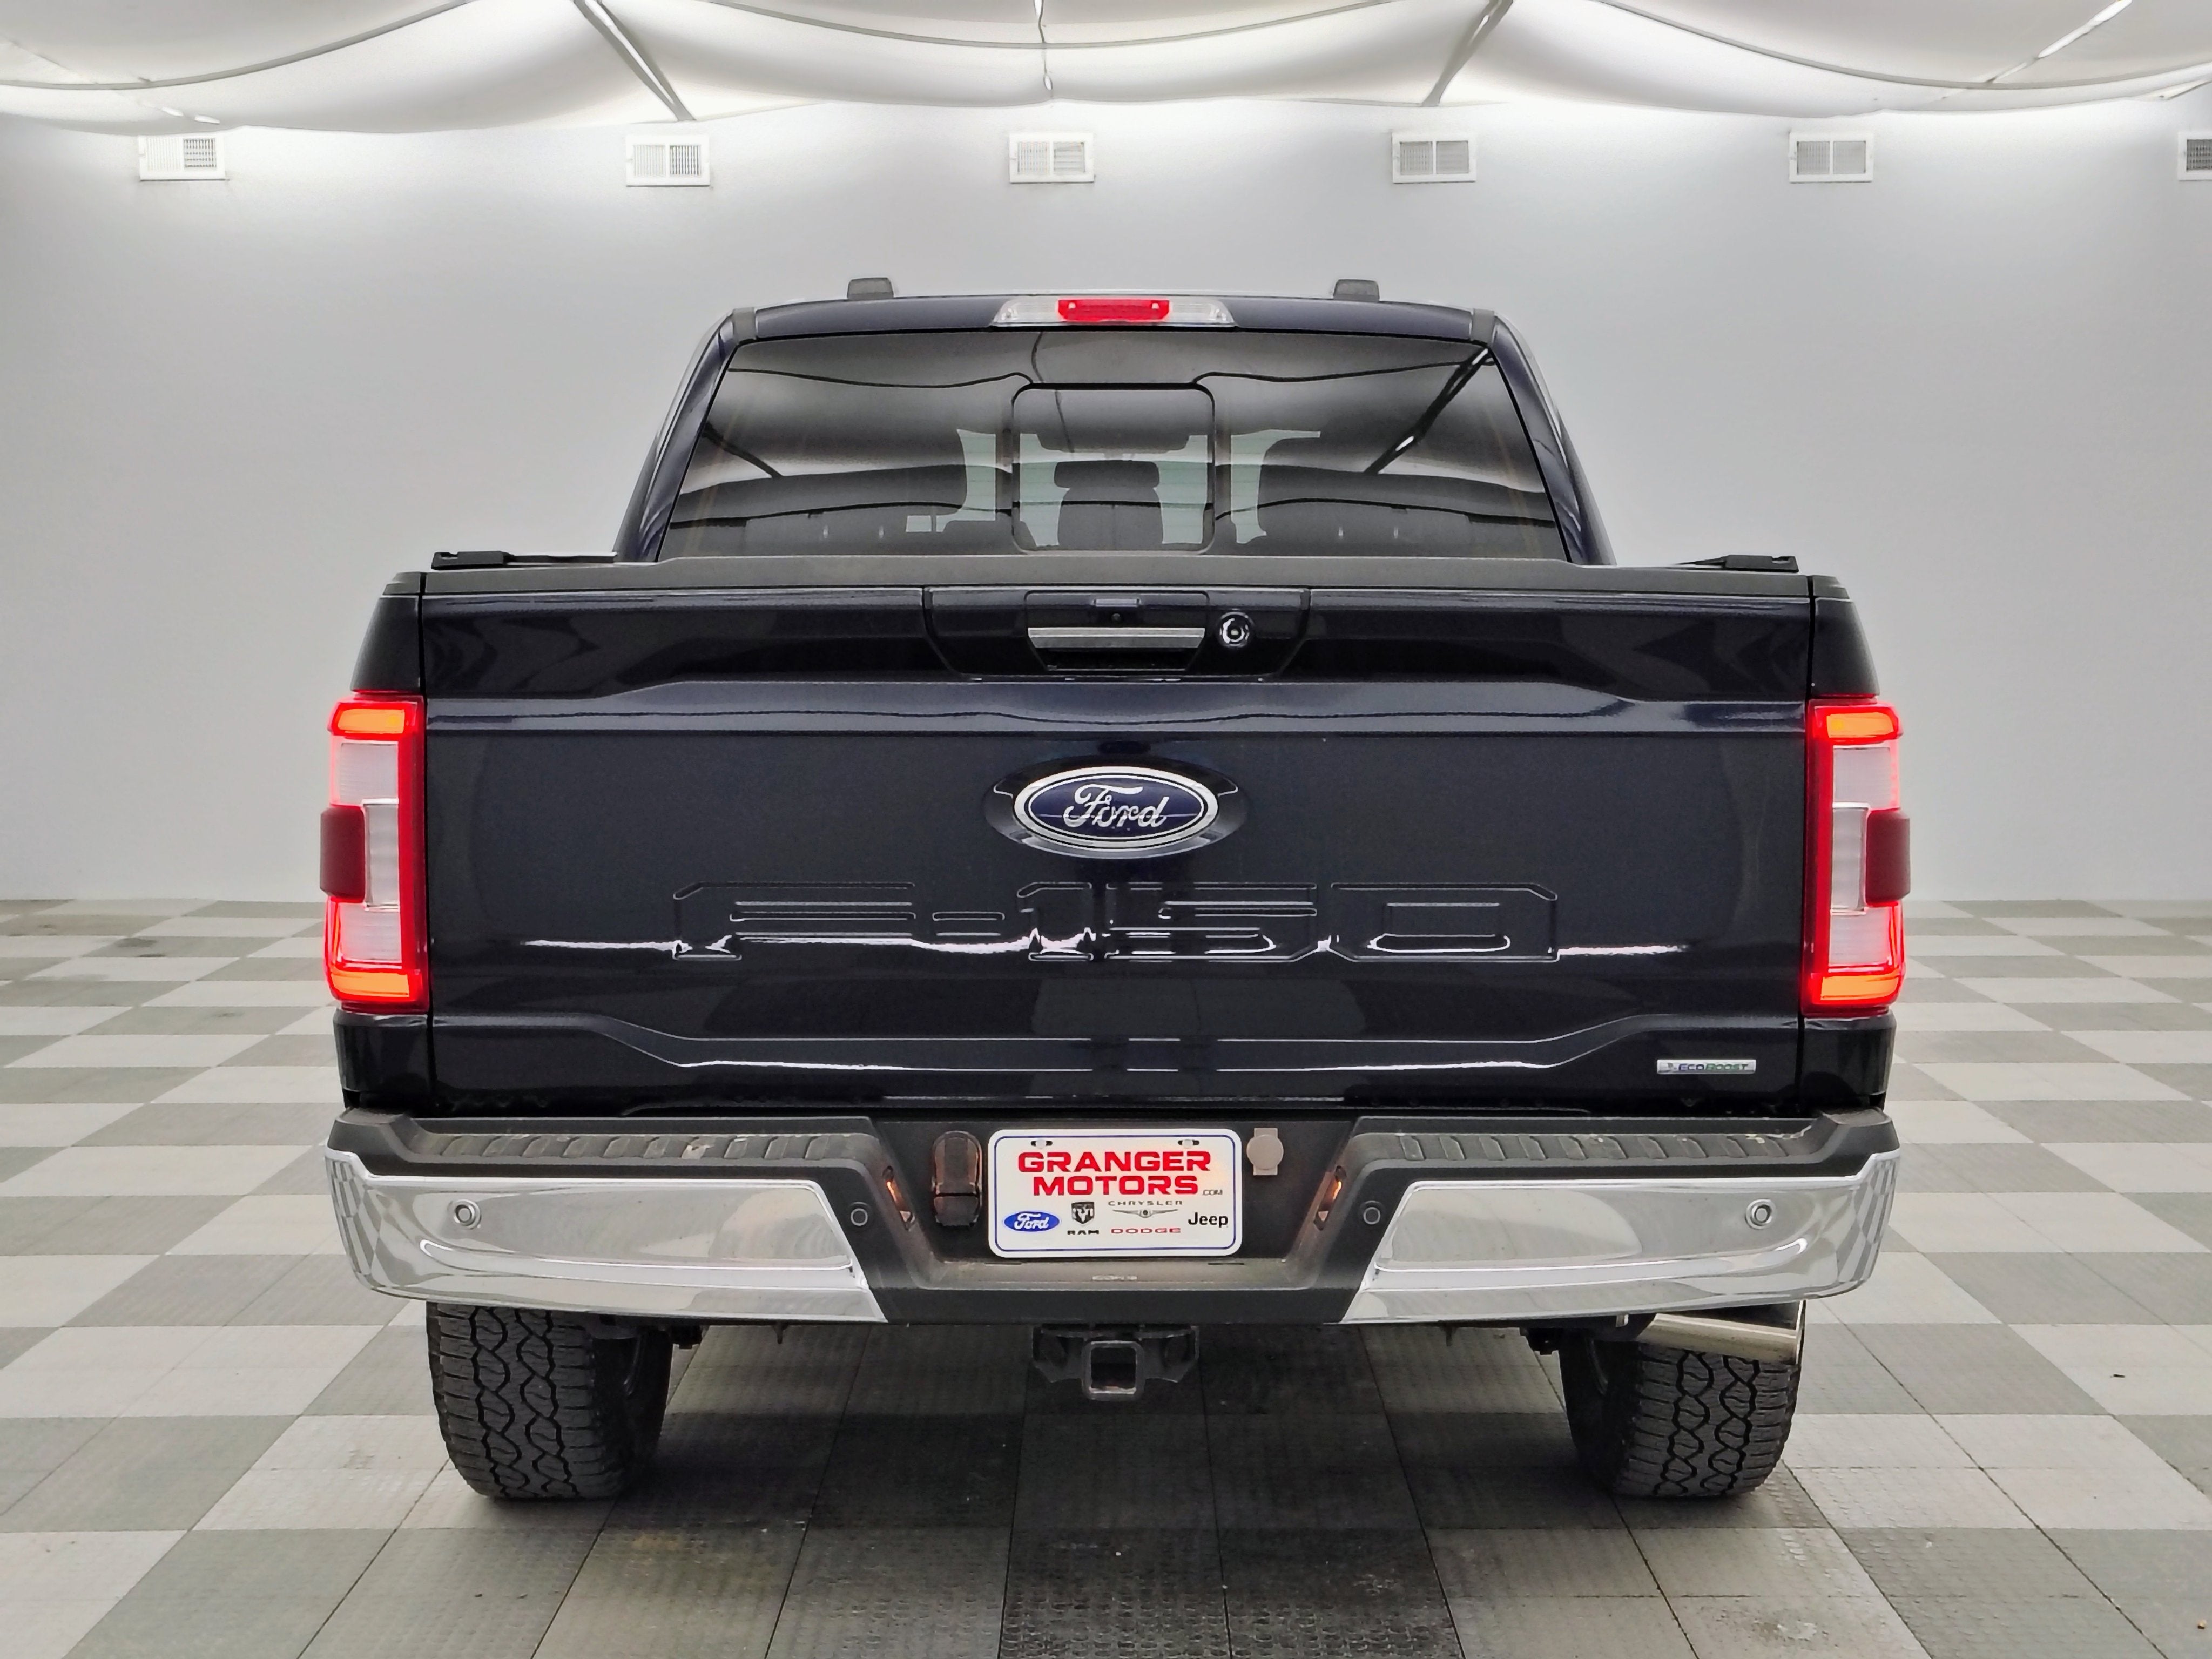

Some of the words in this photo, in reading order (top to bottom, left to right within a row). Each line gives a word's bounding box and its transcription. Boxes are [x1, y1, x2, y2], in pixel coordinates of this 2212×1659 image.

[1063, 784, 1170, 828] Ford
[673, 882, 1559, 962] F-150
[1018, 1151, 1211, 1172] GRANGER
[1033, 1175, 1198, 1196] MOTORS
[1014, 1212, 1050, 1229] Ford
[1188, 1212, 1229, 1229] Jeep
